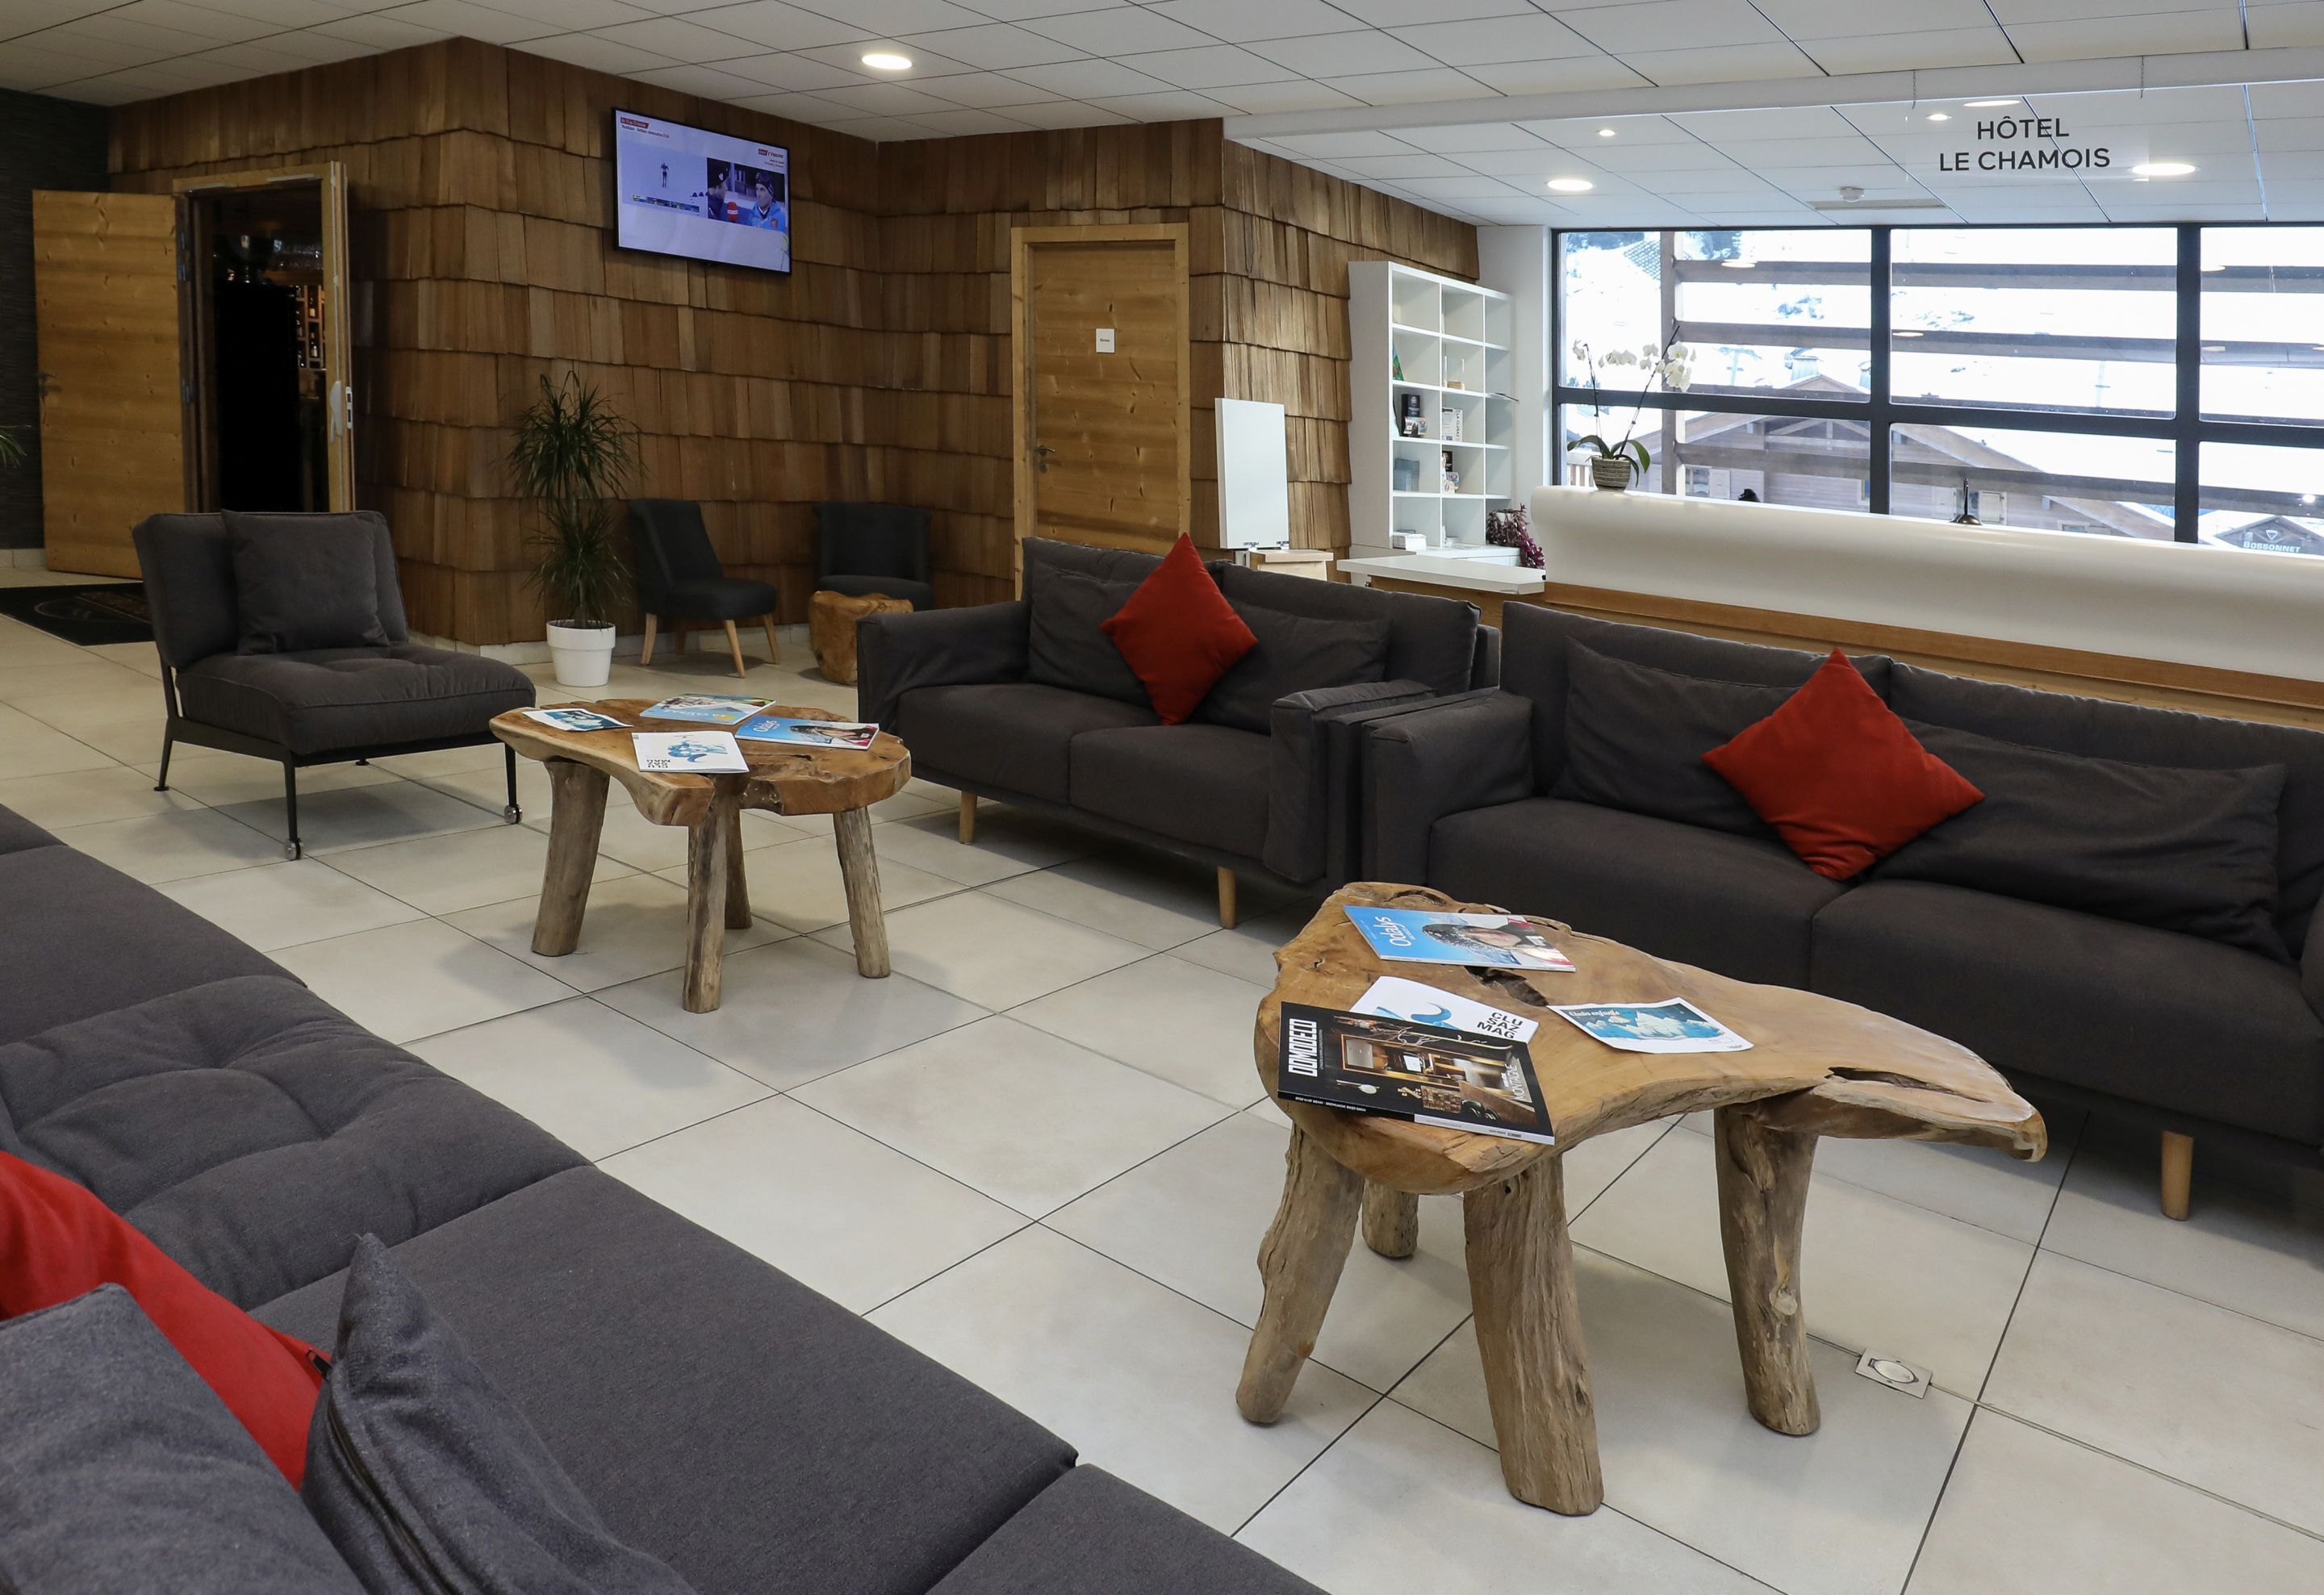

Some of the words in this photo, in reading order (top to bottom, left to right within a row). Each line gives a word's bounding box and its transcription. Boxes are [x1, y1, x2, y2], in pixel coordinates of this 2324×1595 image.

[1977, 116, 2070, 140] HÔTEL
[1940, 152, 1969, 171] LE
[1978, 148, 2111, 171] CHAMOIS
[2243, 541, 2301, 553] BOSSONNET
[1373, 916, 1411, 946] Odalys
[1486, 1017, 1519, 1033] SAZ
[1491, 1012, 1524, 1026] CLU
[1477, 1021, 1515, 1039] MAG
[1289, 1018, 1318, 1077] DOMODECO
